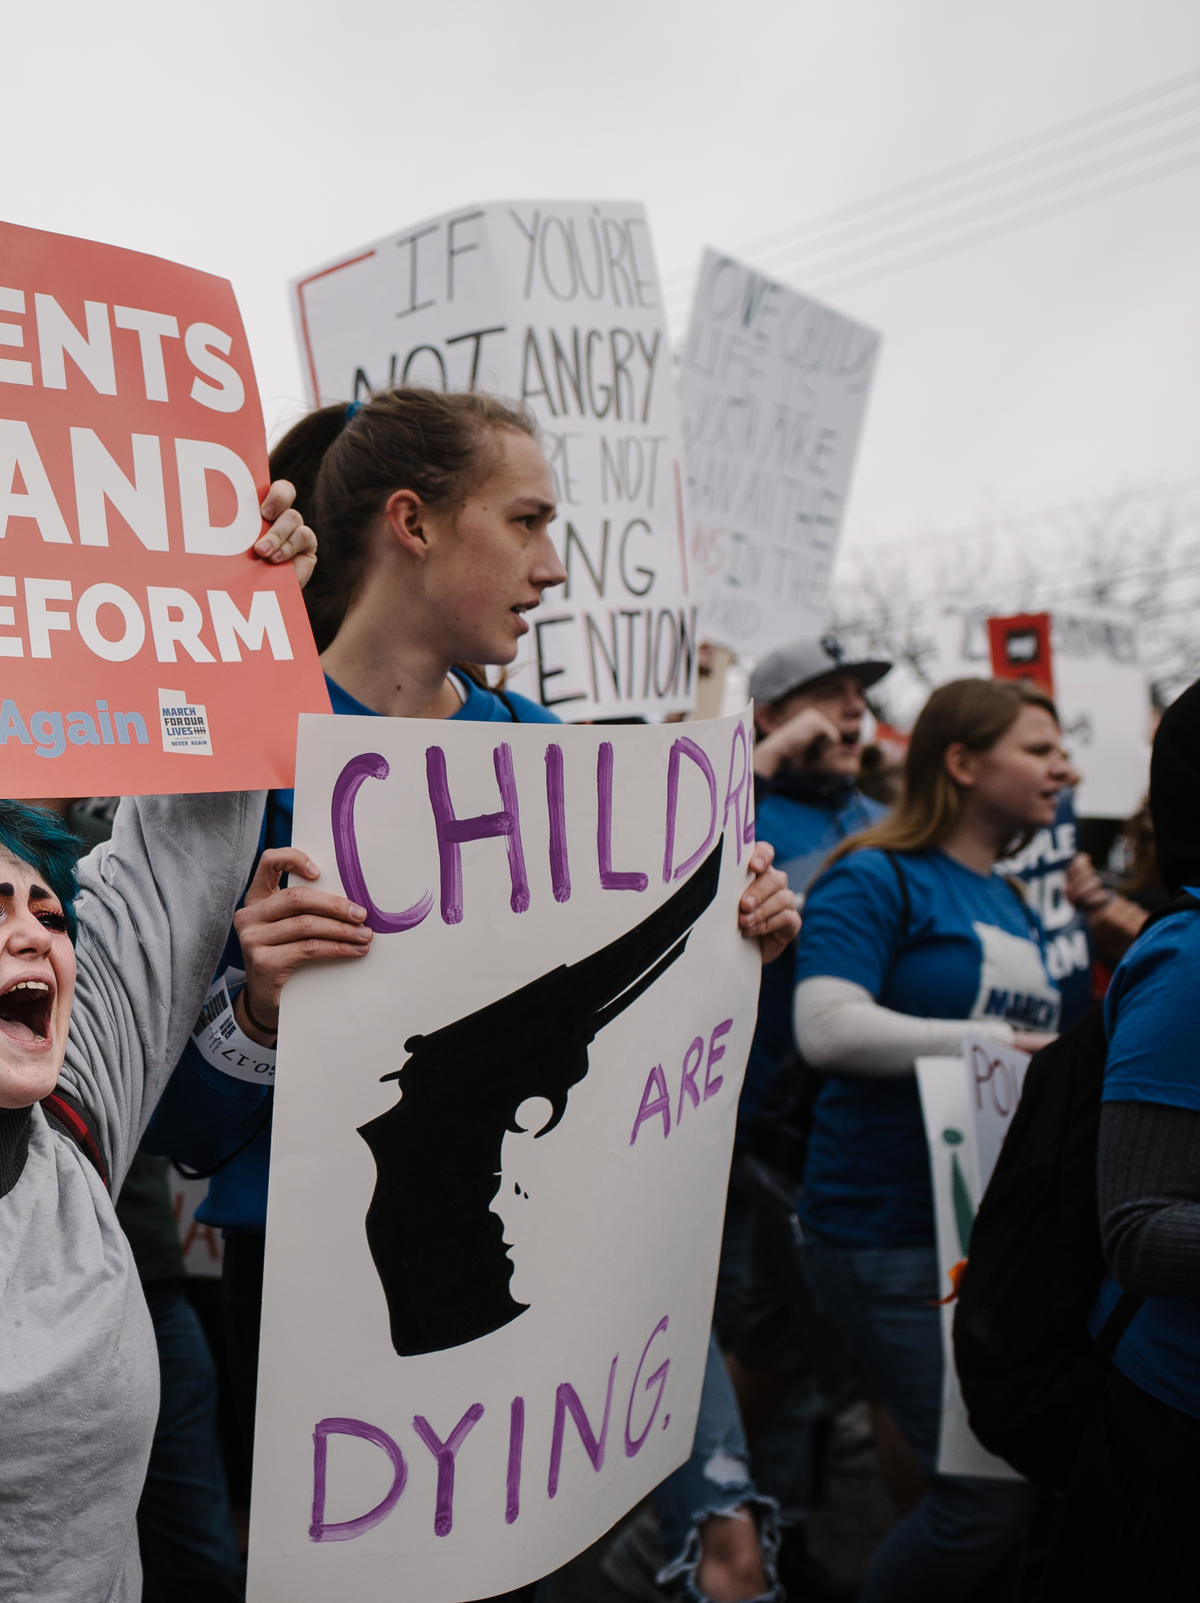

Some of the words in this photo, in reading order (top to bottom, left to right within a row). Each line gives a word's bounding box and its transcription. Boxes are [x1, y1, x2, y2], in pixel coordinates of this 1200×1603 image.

[396, 210, 484, 318] IF
[521, 324, 661, 426] ANGRY
[599, 433, 666, 508] NOT
[533, 604, 699, 708] ENTION
[162, 707, 197, 717] MARCH
[164, 717, 183, 726] FOR
[184, 716, 204, 726] OUR
[166, 726, 193, 736] LIVES
[629, 1017, 734, 1147] ARE
